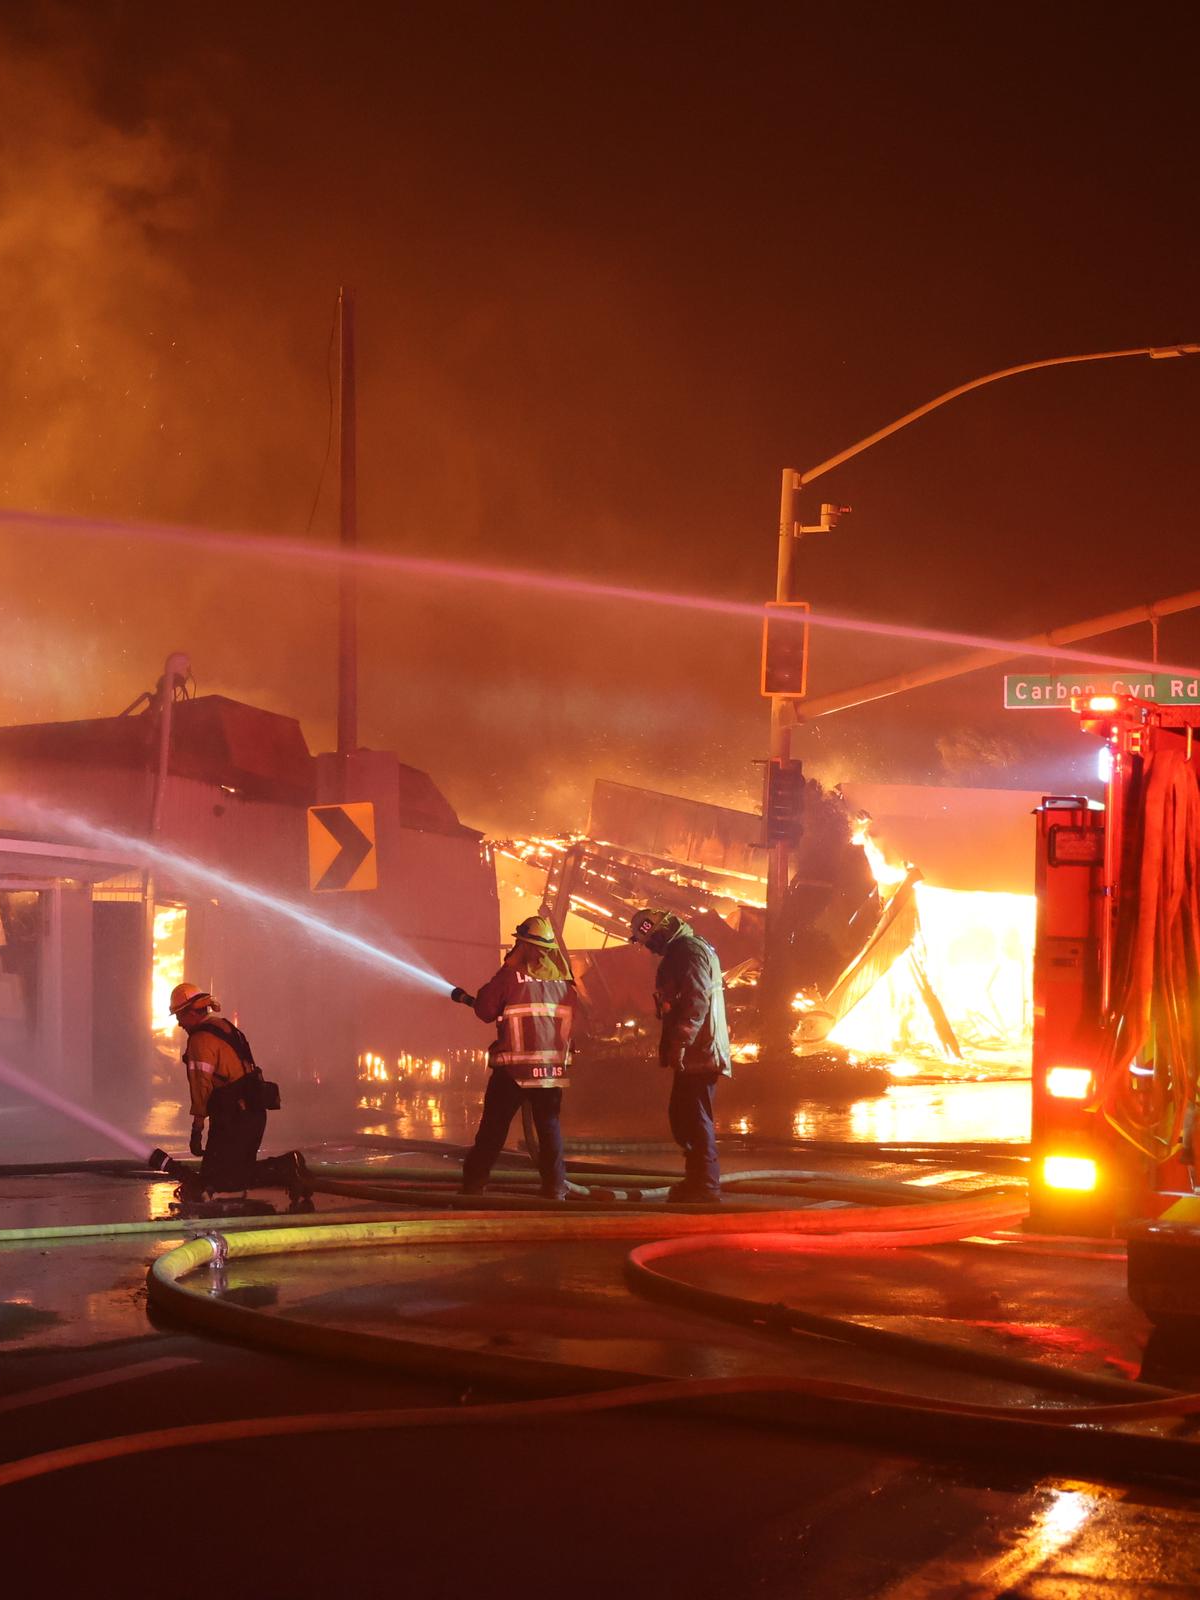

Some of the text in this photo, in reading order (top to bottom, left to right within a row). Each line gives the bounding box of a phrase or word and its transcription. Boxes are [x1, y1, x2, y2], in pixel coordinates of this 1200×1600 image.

[1015, 681, 1095, 700] Carbon
[1170, 679, 1200, 698] Rd
[639, 921, 652, 933] 18
